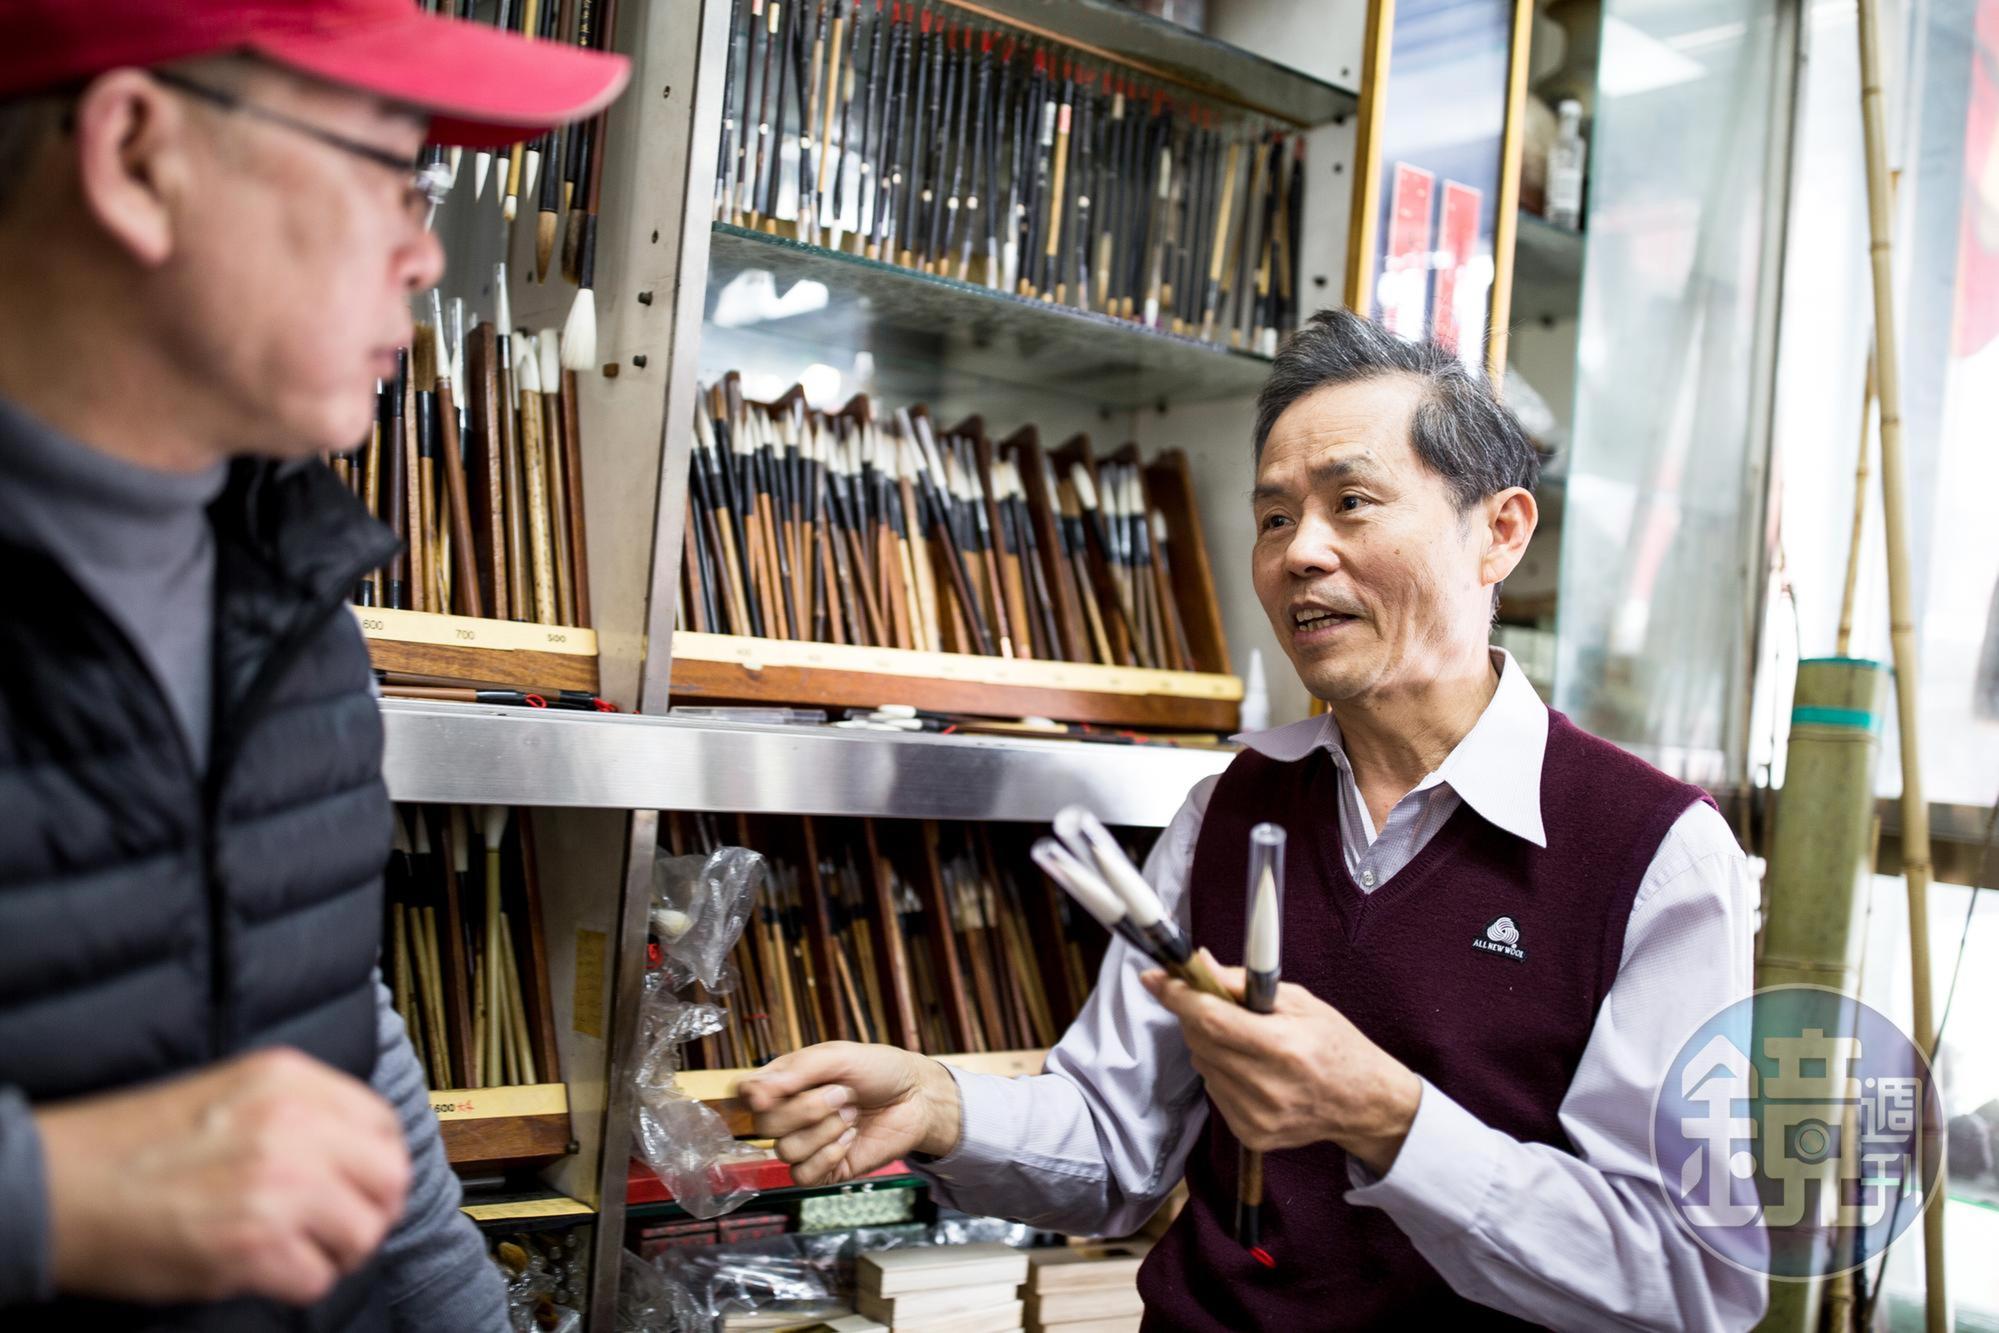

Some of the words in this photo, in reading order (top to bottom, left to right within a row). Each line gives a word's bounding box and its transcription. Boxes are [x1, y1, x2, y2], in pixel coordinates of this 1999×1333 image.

[455, 629, 476, 641] 700
[1472, 939, 1487, 949] ALL
[1488, 942, 1505, 953] NEW
[1505, 946, 1524, 958] WOOL
